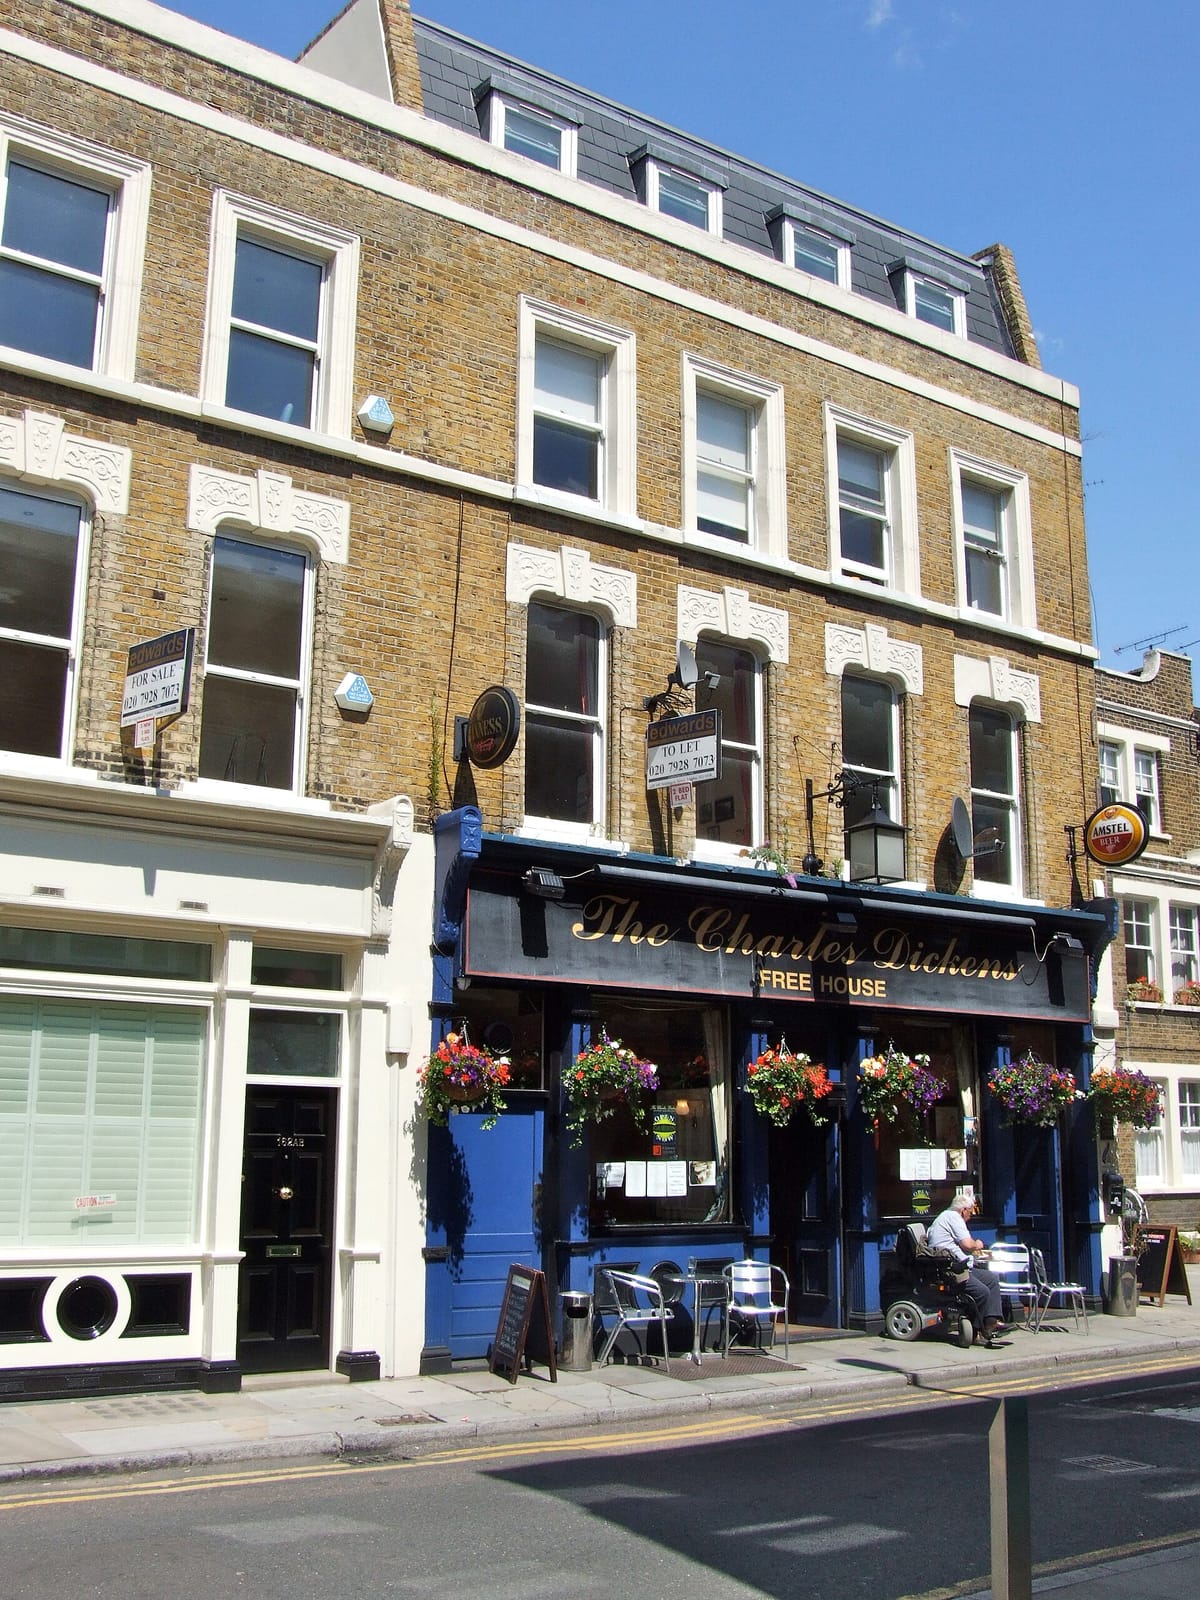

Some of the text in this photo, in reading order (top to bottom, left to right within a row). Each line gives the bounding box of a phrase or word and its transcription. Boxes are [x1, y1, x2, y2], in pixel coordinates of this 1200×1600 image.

[129, 635, 184, 667] edwards
[131, 664, 177, 688] FOR SALE
[123, 683, 180, 710] 020 7928 7073
[650, 714, 714, 740] edwards
[662, 740, 701, 758] TO LET
[649, 754, 714, 777] 020 7928 7073
[674, 793, 689, 802] FLAT
[678, 786, 690, 795] BED
[1093, 822, 1129, 837] AMSTEL
[1100, 836, 1120, 846] BEER
[571, 894, 1025, 982] The Charles Dickens
[758, 968, 888, 998] FREE HOUSE
[654, 1113, 675, 1122] OPEN
[76, 1197, 98, 1208] CAUTION
